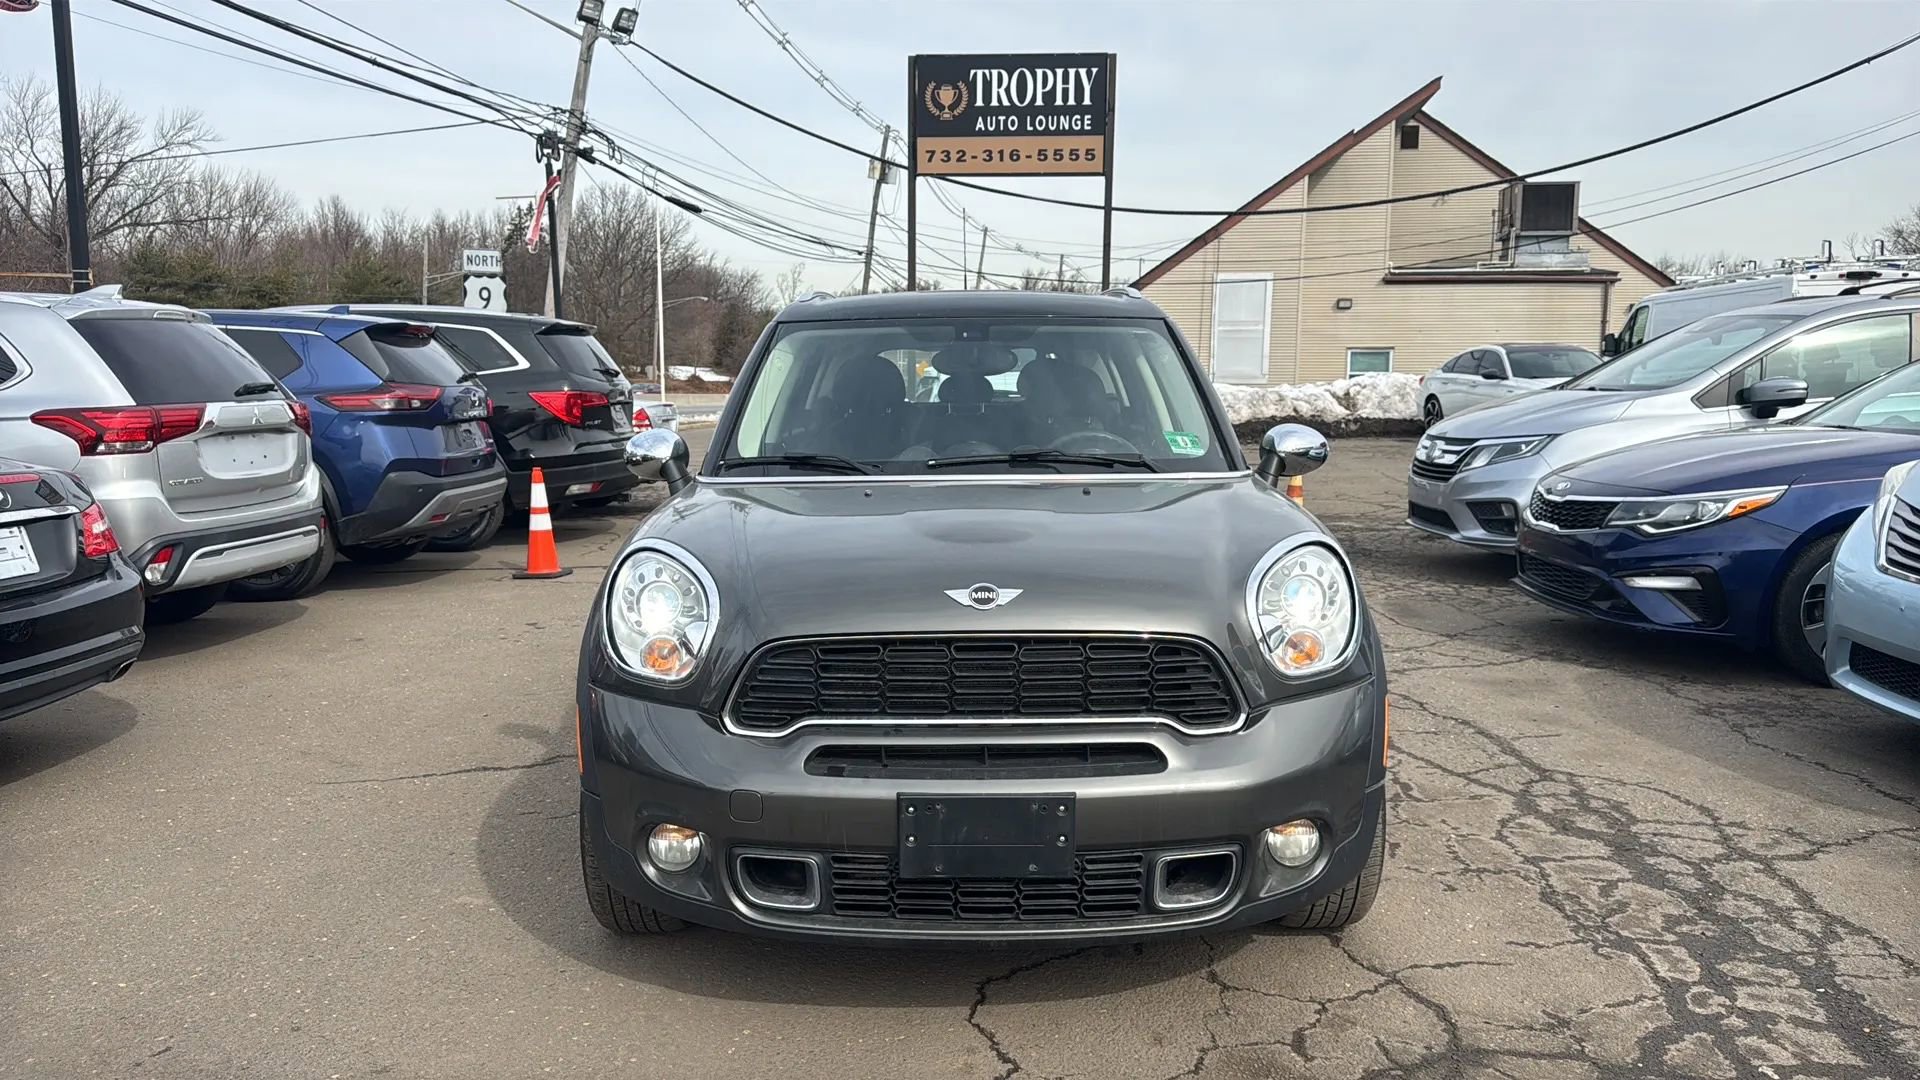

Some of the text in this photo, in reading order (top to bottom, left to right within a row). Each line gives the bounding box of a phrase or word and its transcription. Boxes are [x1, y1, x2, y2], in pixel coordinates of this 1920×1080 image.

[969, 67, 1099, 107] TROPHY
[975, 115, 1092, 131] AUTO LOUNGE
[925, 149, 1096, 163] 732-316-5555
[466, 254, 501, 267] NORTH
[478, 286, 491, 309] 9
[971, 591, 996, 599] MINI
